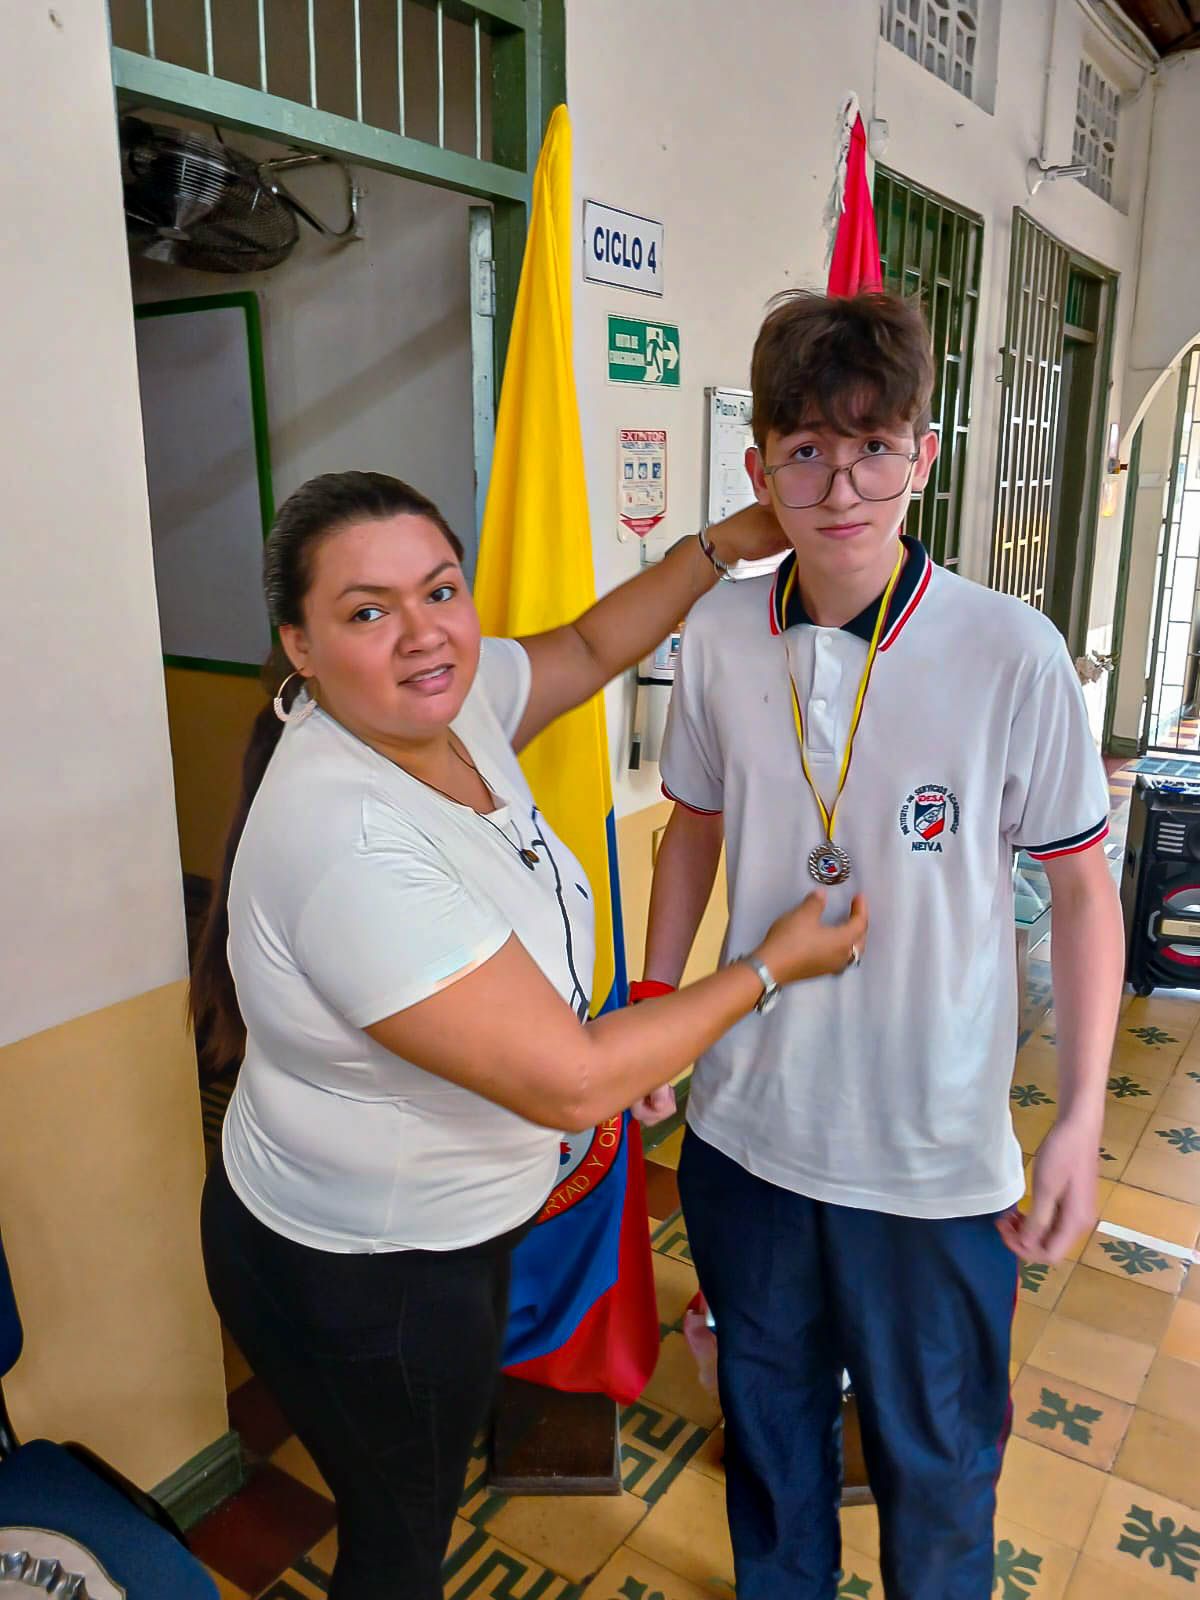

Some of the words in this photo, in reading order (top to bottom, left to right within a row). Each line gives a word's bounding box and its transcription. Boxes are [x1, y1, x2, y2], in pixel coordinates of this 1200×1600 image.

[593, 226, 643, 271] CICLO
[647, 241, 657, 274] 4
[620, 431, 665, 442] EXTINTOR
[912, 841, 943, 853] NEIVA
[542, 1175, 592, 1215] RTAD
[587, 1154, 604, 1169] Y
[598, 1115, 619, 1148] OR
